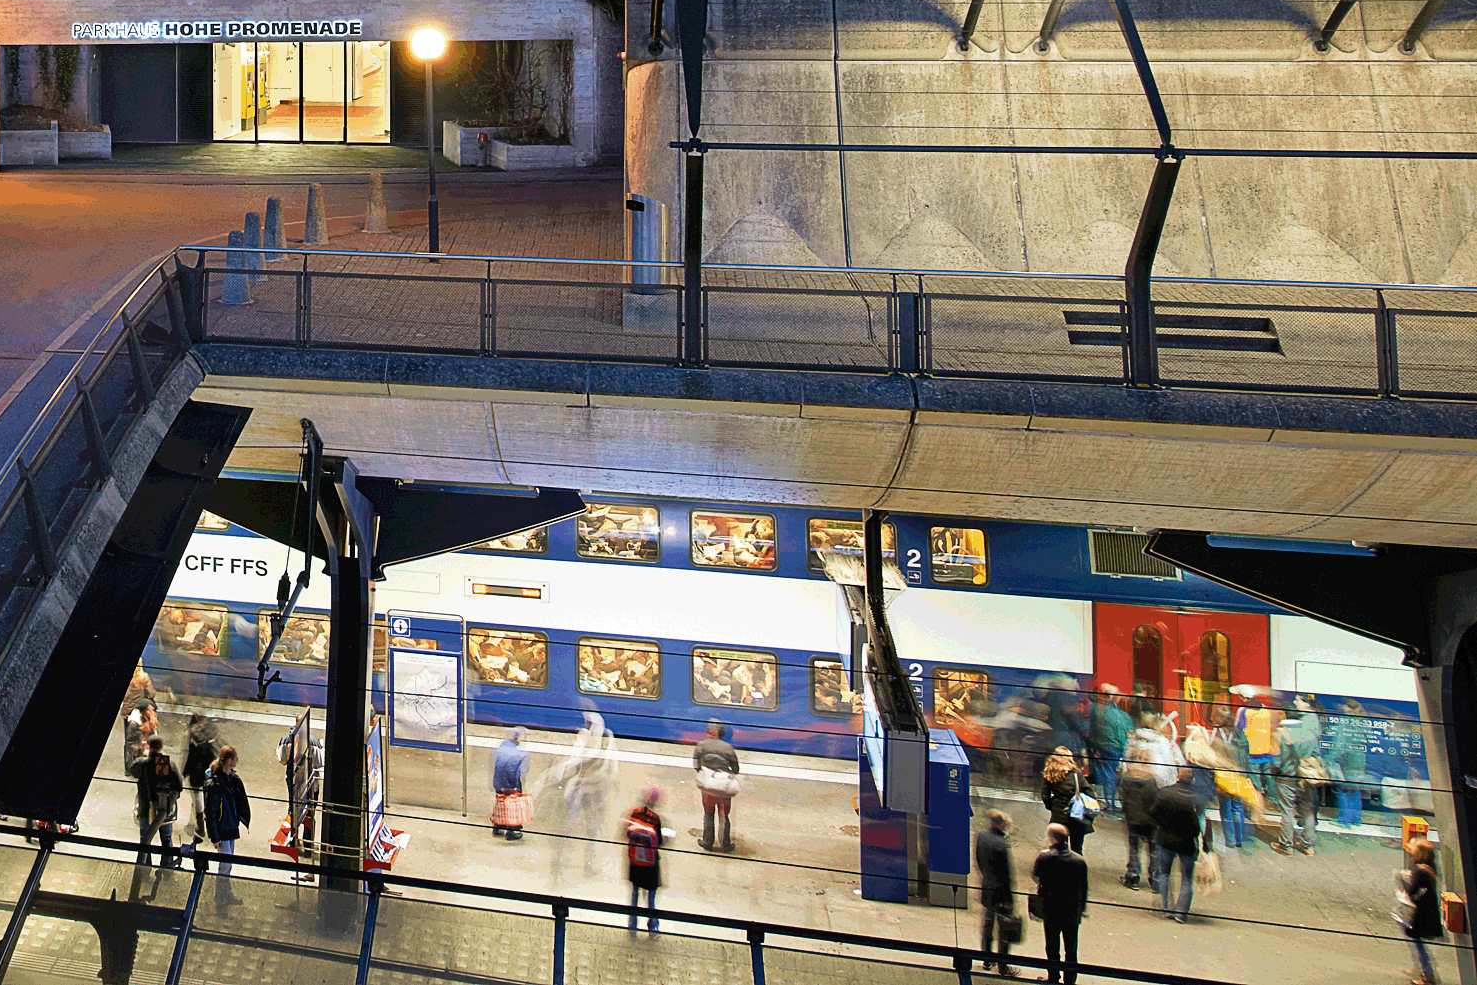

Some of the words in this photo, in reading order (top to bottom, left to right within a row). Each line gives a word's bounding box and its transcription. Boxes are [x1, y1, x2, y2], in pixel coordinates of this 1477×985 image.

[73, 23, 159, 37] PARKHAUS
[165, 23, 202, 36] HOHE
[228, 22, 362, 36] PROMENADE
[184, 554, 224, 573] CFF
[230, 557, 268, 577] FFS
[906, 548, 922, 568] 2
[908, 662, 924, 682] 2
[1329, 716, 1340, 724] 50
